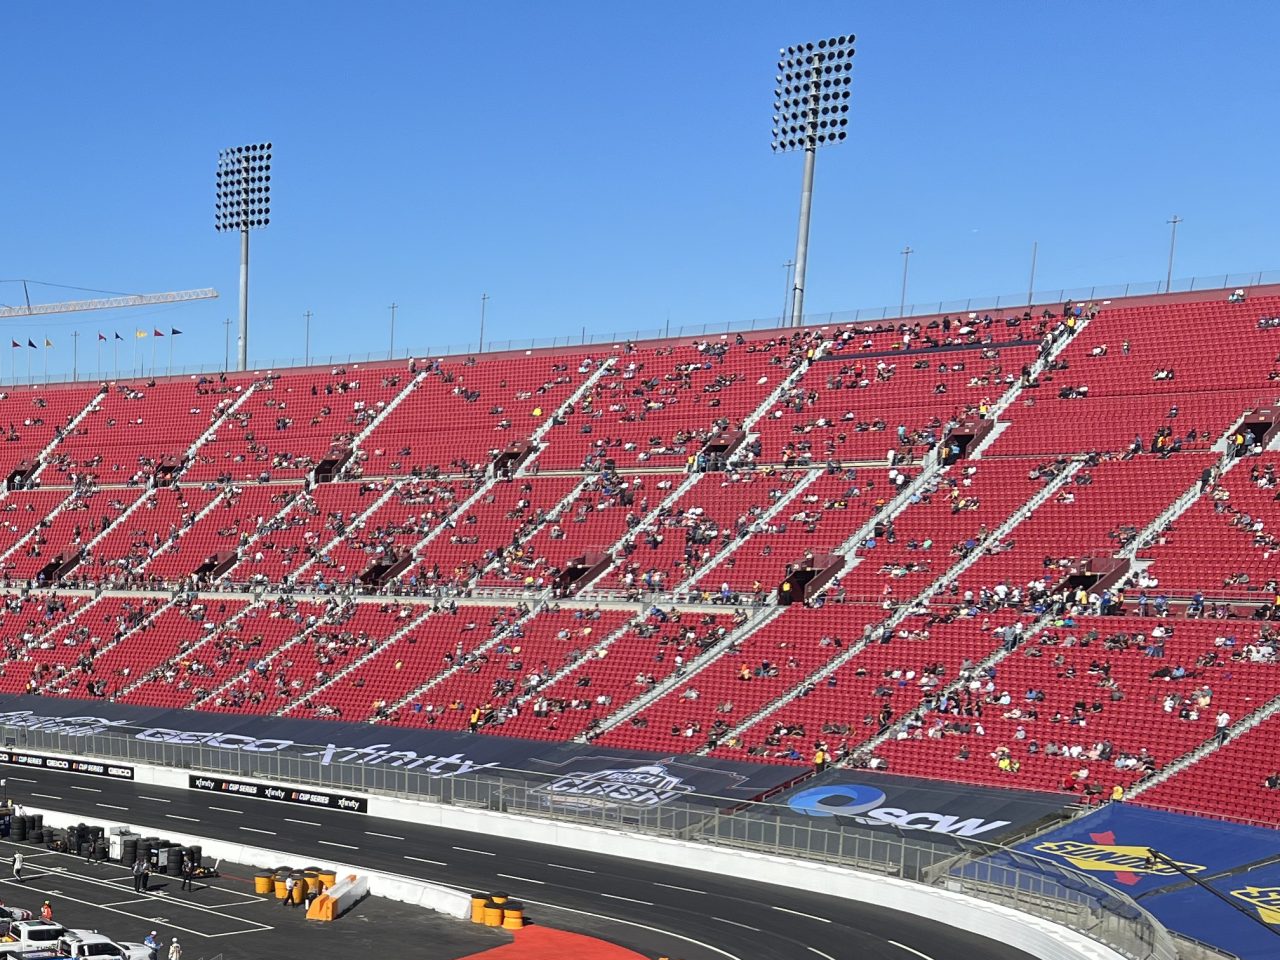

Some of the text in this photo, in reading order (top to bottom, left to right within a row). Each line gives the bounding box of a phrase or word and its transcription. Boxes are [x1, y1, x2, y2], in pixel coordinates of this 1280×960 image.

[135, 728, 294, 751] GEICO
[46, 760, 68, 768] GEICO
[108, 767, 131, 776] GEICO
[302, 743, 500, 779] xfinity
[195, 778, 359, 810] xfinity CUP SERIES xfinity CUP SERIES xfinity
[547, 778, 677, 804] CLASH
